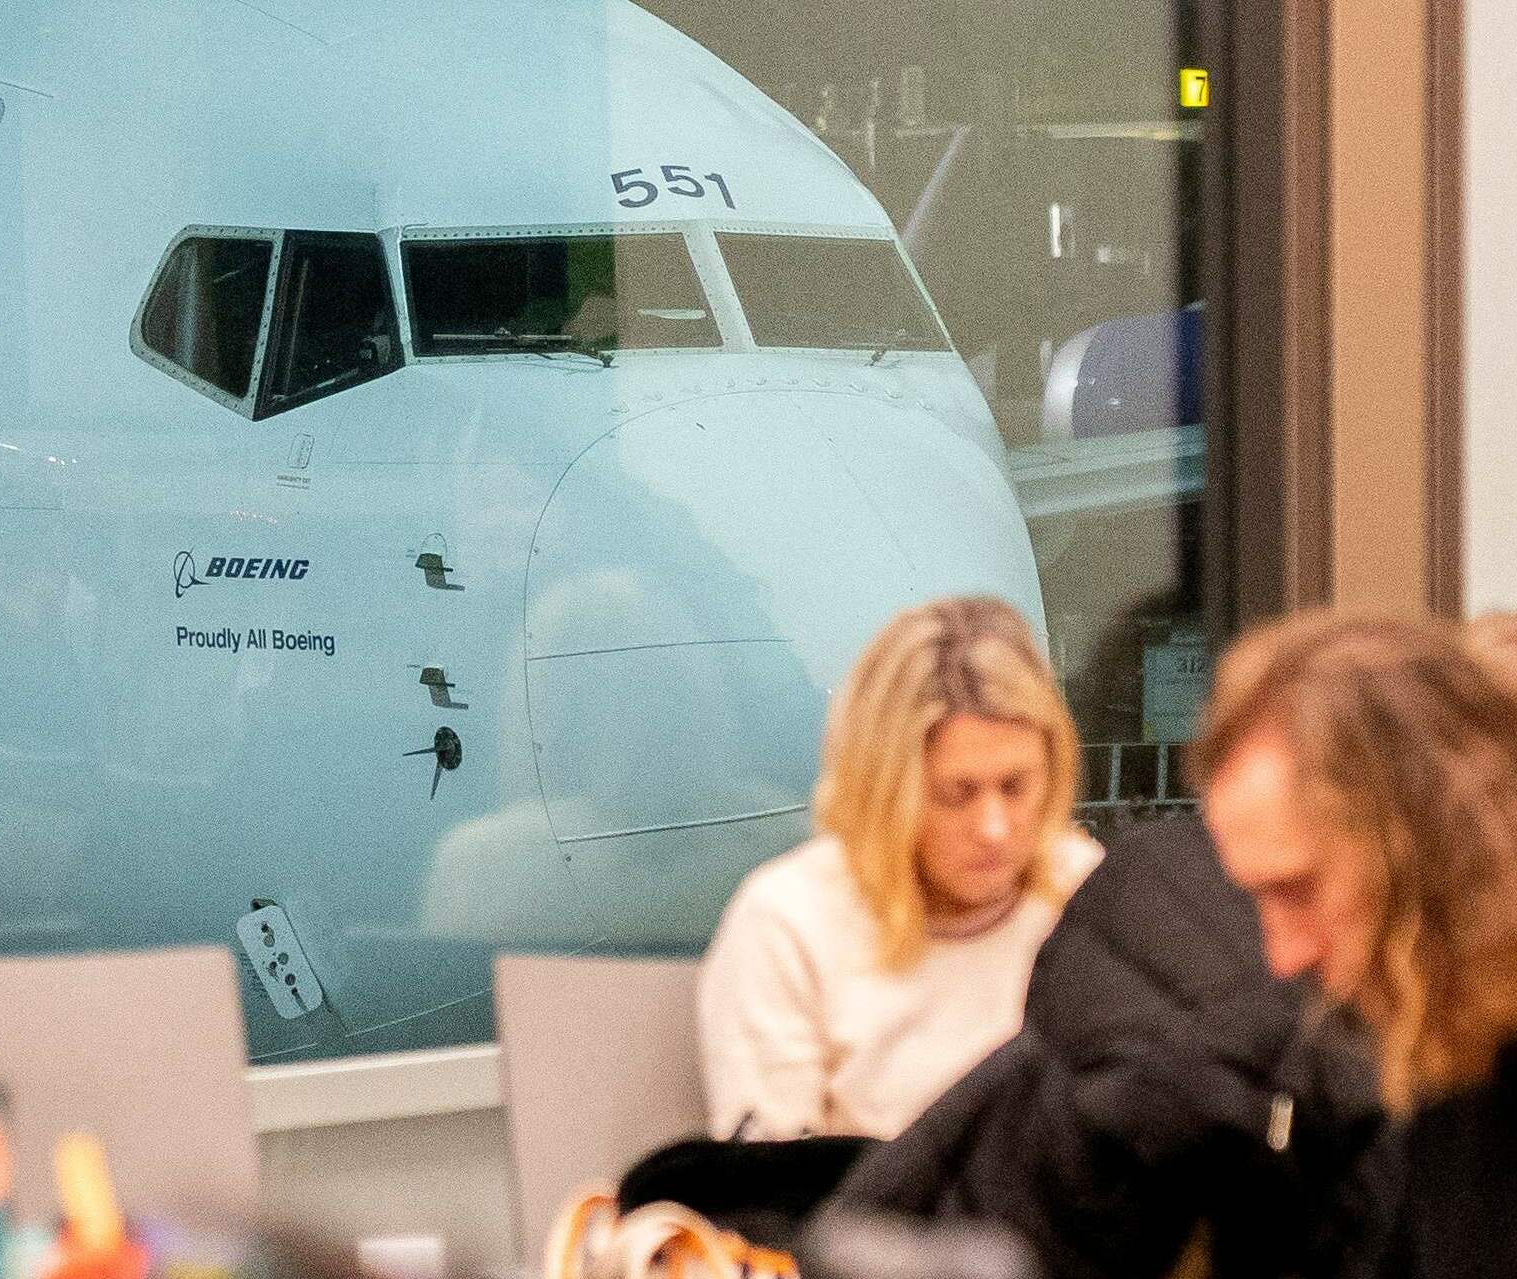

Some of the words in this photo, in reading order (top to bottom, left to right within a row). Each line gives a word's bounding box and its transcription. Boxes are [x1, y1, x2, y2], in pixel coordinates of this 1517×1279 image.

[610, 165, 736, 209] 551
[205, 557, 310, 580] BOEING
[176, 626, 241, 653] Proudly
[247, 628, 267, 649] All
[272, 630, 336, 656] Boeing
